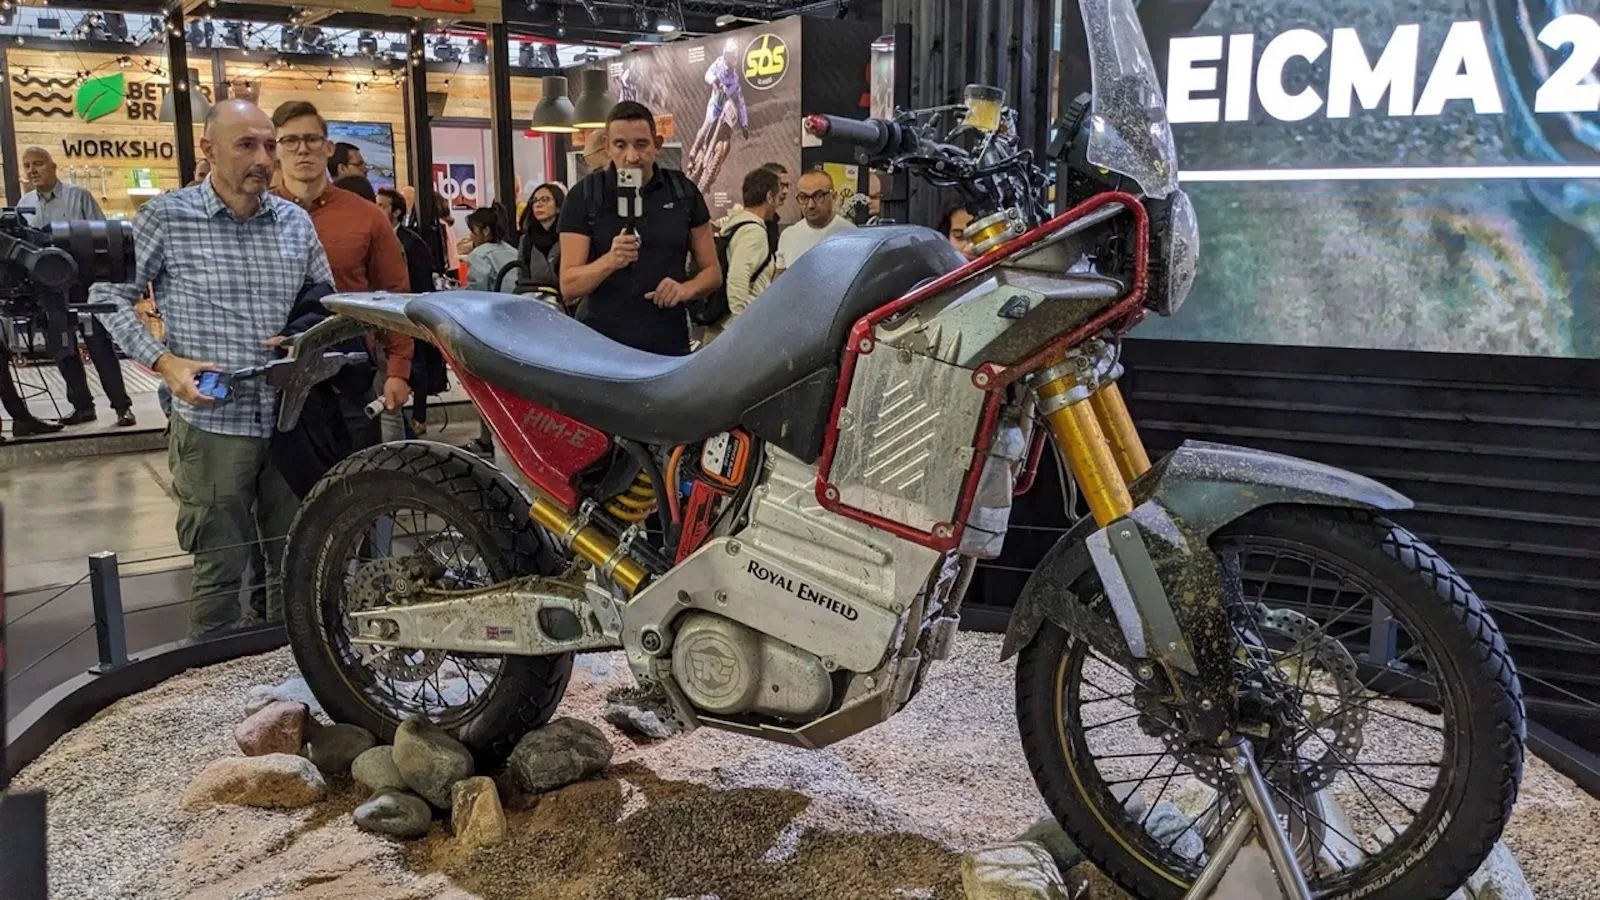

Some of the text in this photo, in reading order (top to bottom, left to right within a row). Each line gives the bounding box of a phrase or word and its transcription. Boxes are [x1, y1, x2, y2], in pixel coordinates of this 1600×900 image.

[1167, 20, 1504, 124] EICMA
[62, 139, 173, 159] WORKSHO
[524, 408, 590, 448] HIM-E
[747, 560, 859, 621] ROYAL ENFIELD
